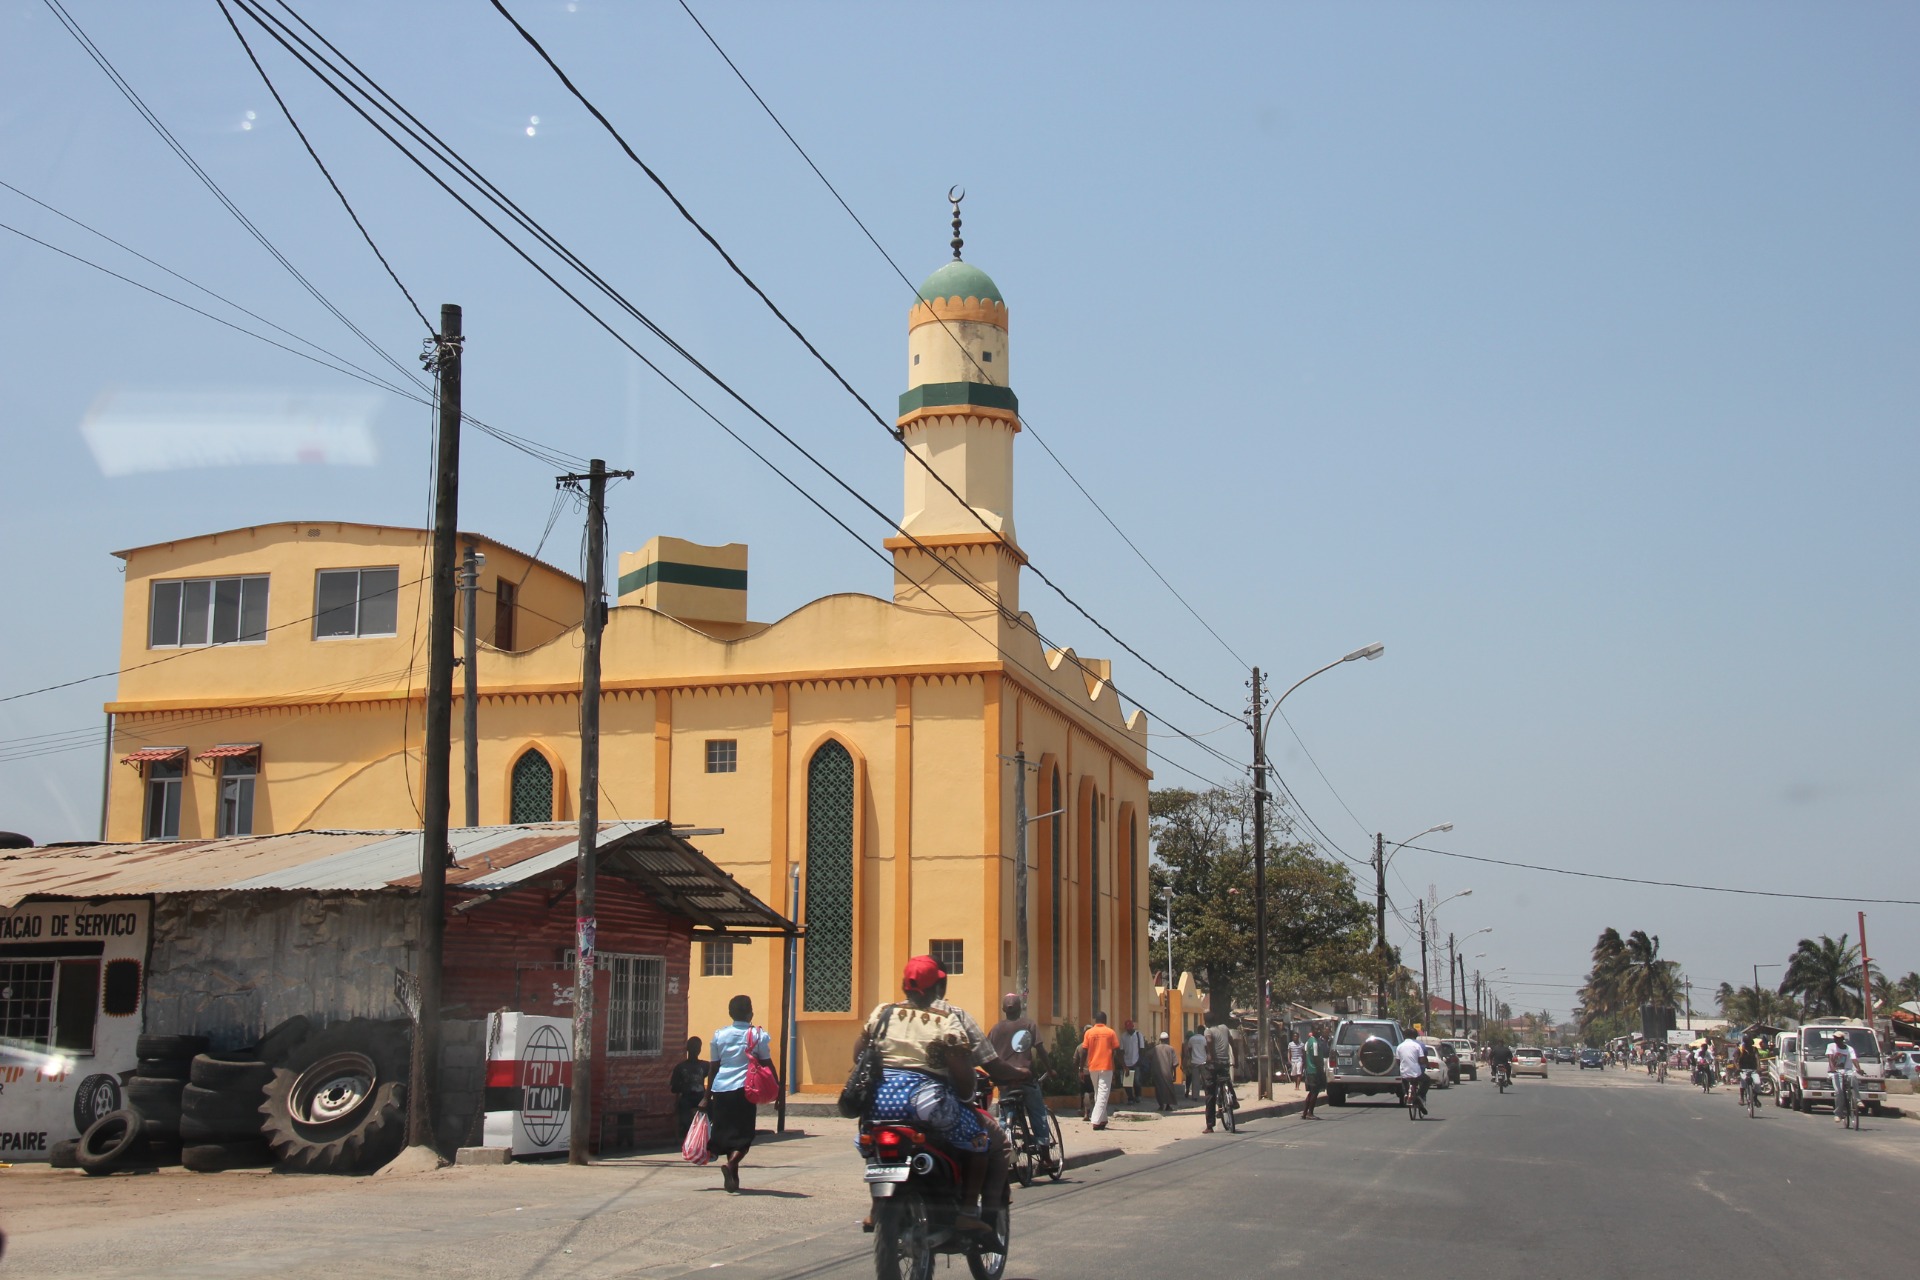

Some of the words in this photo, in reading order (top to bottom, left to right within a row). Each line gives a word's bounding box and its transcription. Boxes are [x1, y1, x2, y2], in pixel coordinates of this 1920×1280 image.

[51, 914, 69, 936] DE
[75, 913, 137, 937] SERVIÇO
[530, 1062, 554, 1085] TIP
[529, 1087, 560, 1109] TOP
[0, 1132, 48, 1151] PAIRE
